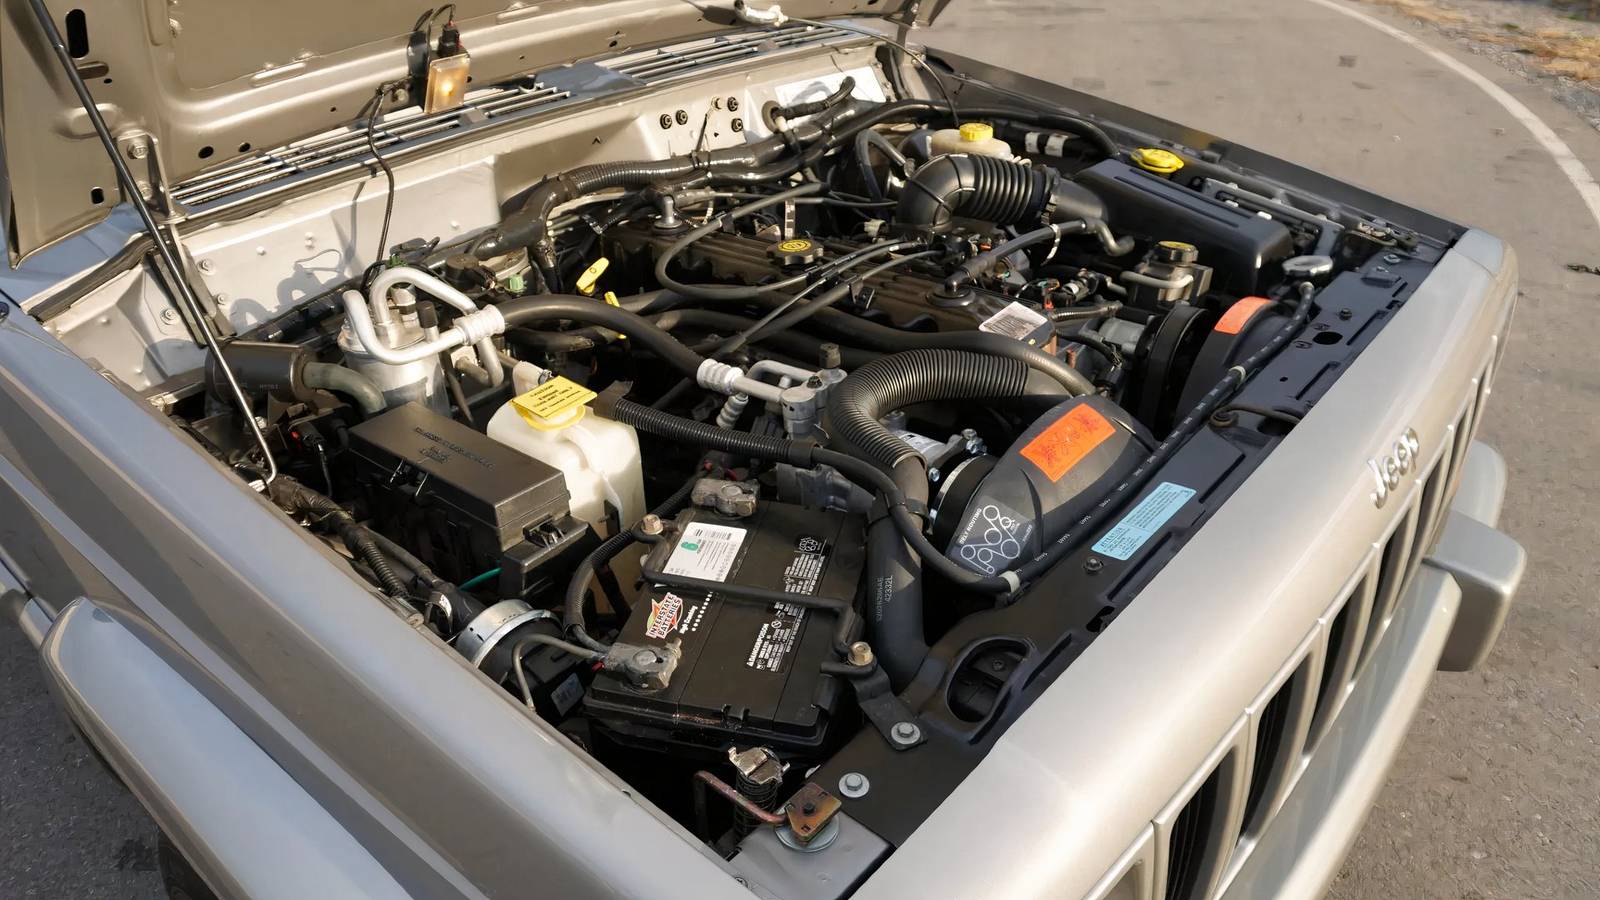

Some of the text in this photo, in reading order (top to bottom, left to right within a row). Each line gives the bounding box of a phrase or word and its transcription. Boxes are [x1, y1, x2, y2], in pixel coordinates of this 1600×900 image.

[1367, 427, 1420, 509] Jeep
[967, 508, 982, 532] ROUTING
[649, 595, 674, 636] INTERSTATE
[658, 599, 680, 636] BATTERIES
